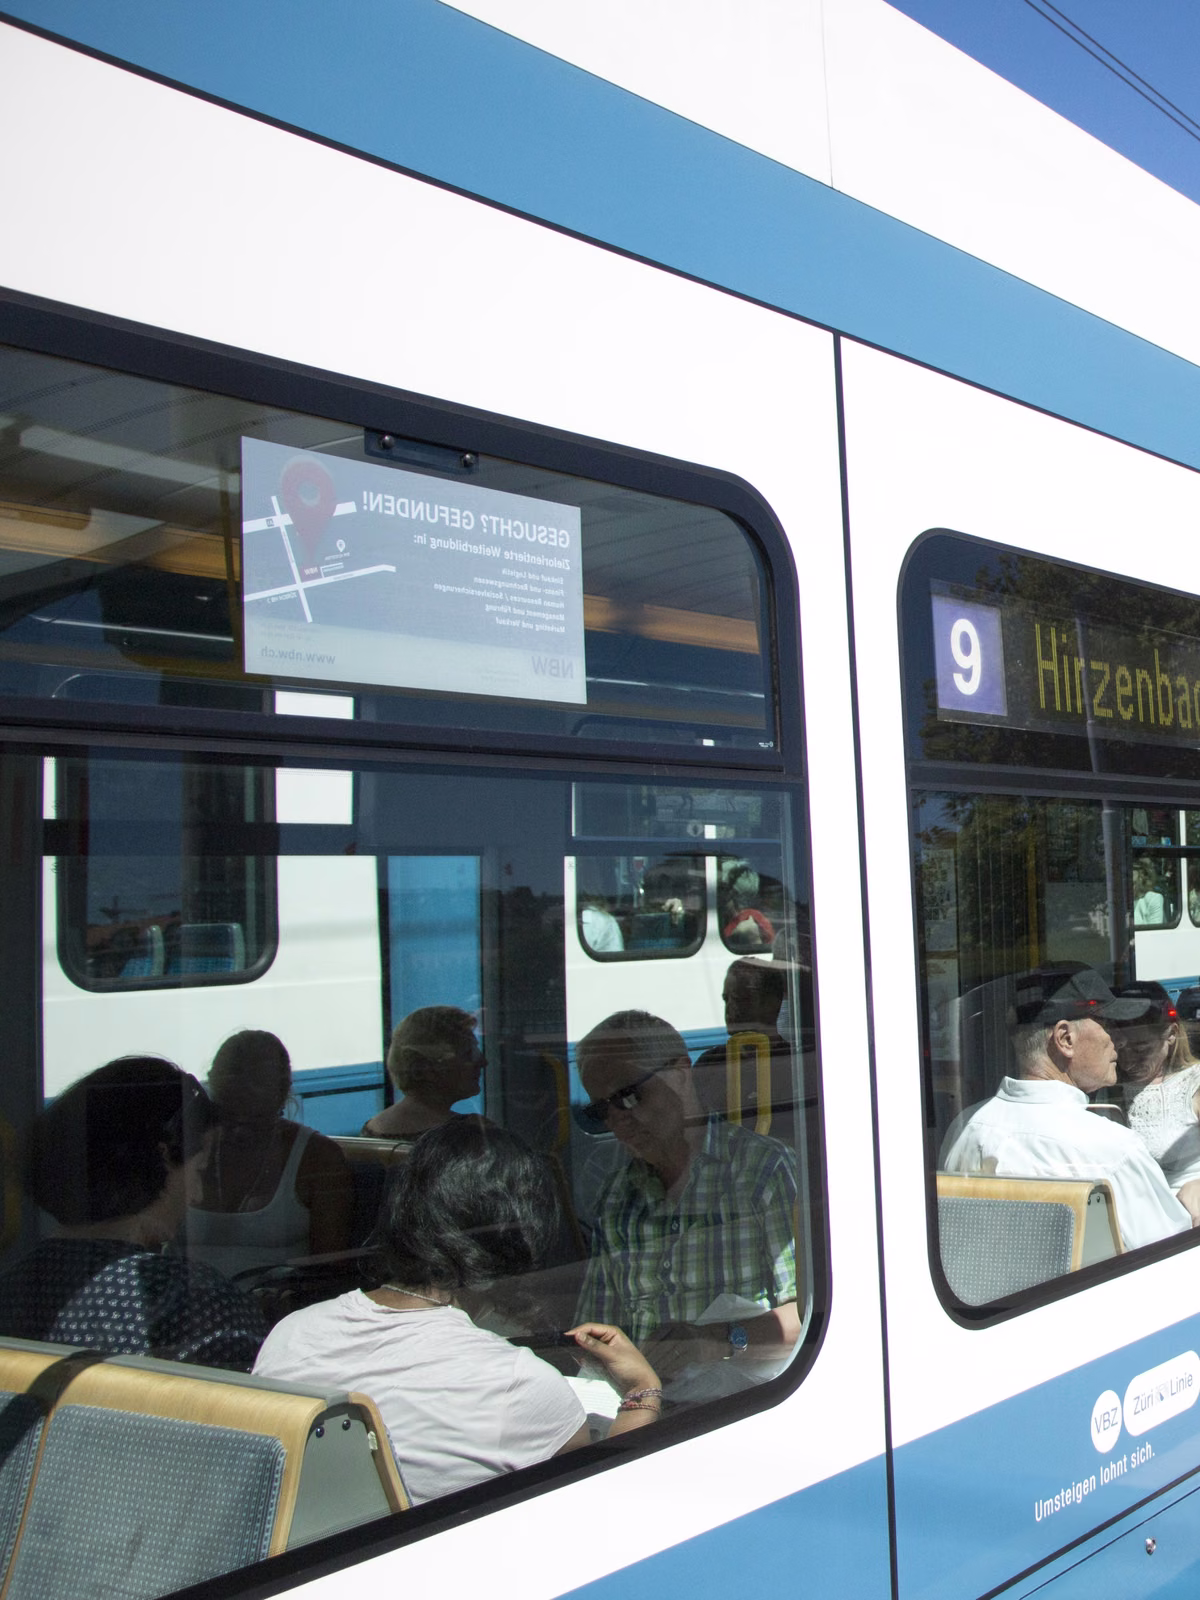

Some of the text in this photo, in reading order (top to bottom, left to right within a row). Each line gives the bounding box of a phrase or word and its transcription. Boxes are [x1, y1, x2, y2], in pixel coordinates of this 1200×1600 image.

[950, 618, 982, 696] 9
[1094, 1407, 1119, 1436] VBZ
[1133, 1372, 1193, 1416] Züri Linie
[1034, 1441, 1156, 1522] Umsteigen lohnt sich.
